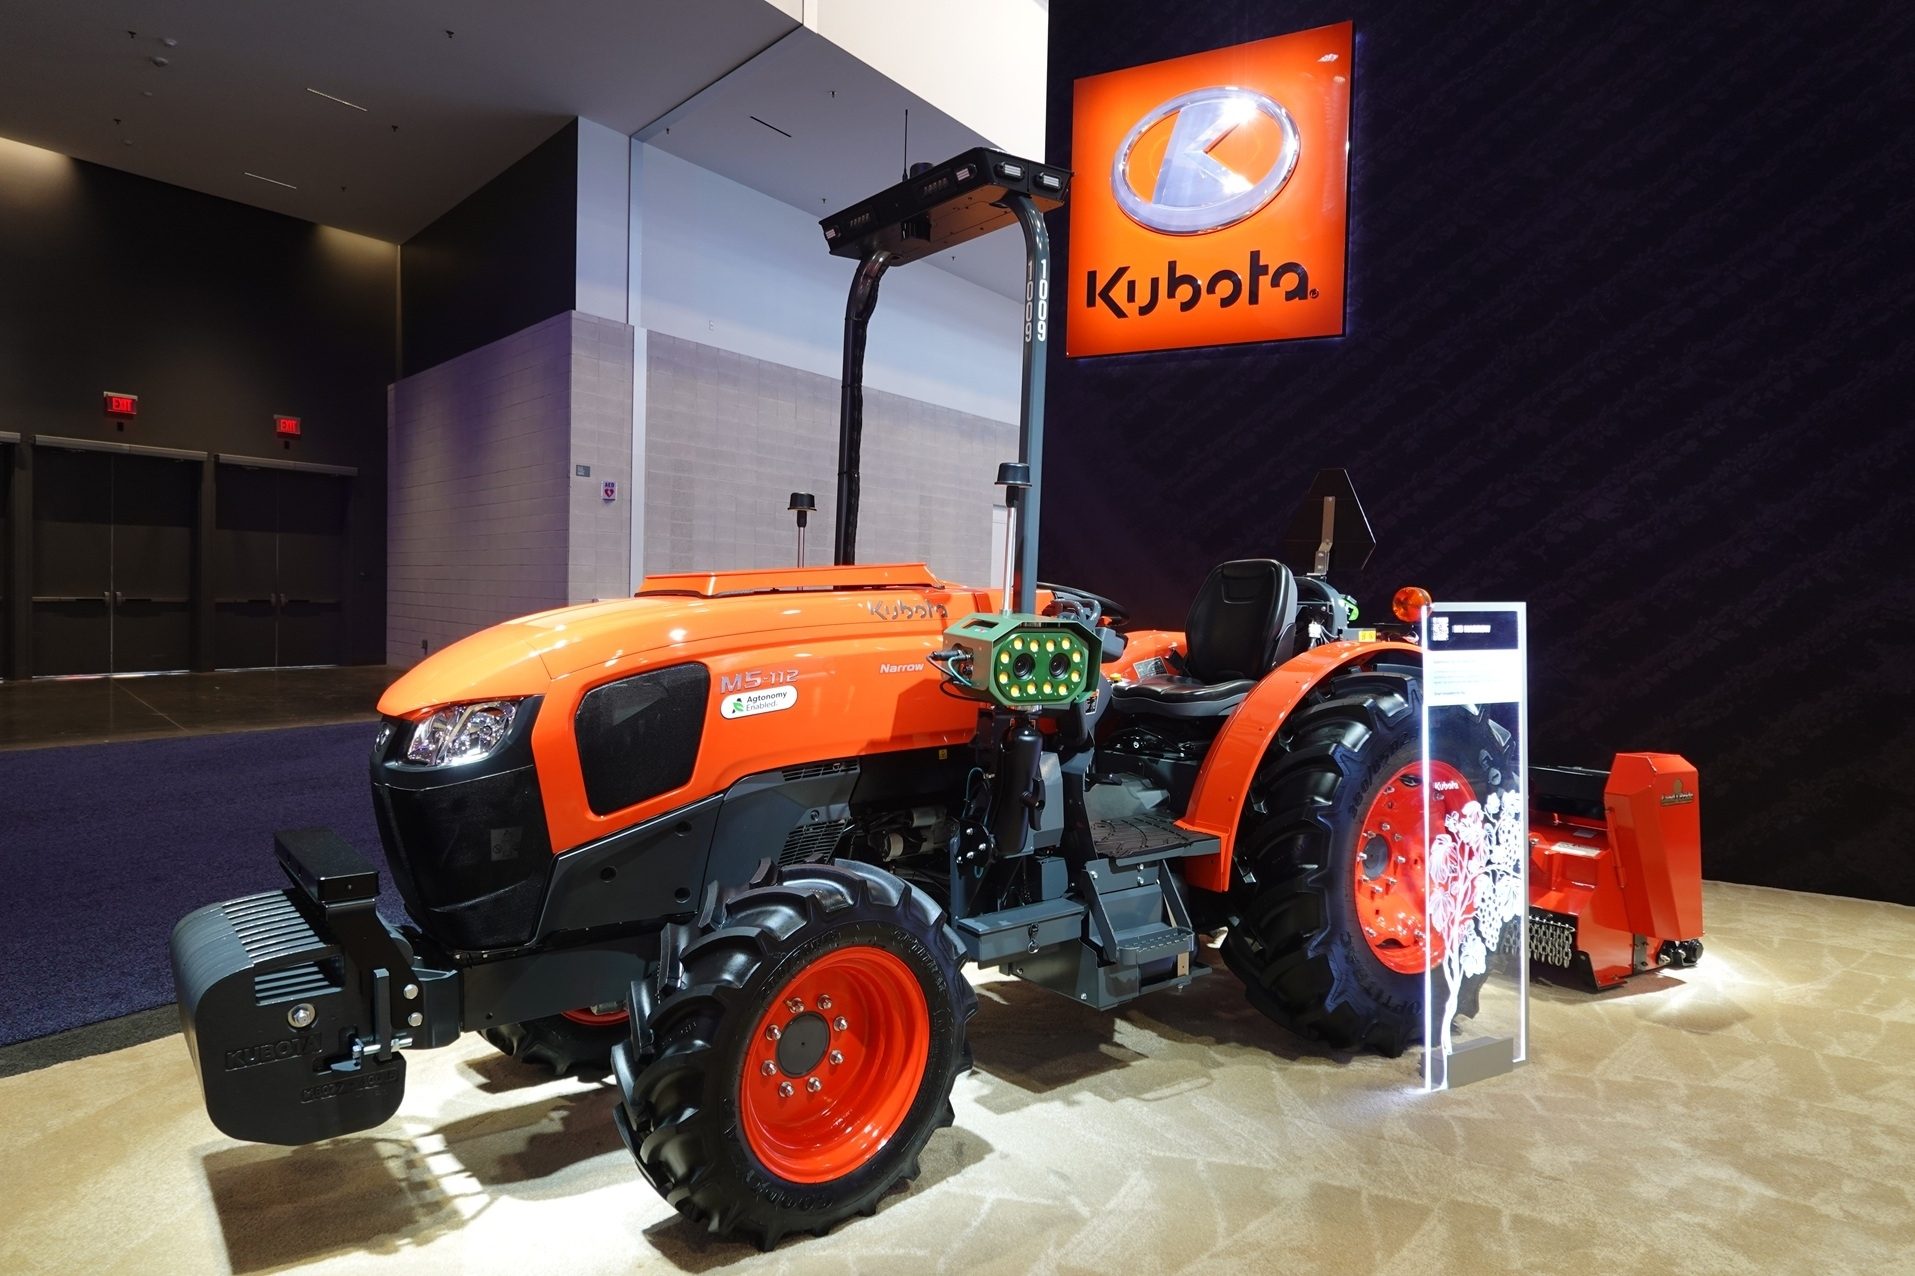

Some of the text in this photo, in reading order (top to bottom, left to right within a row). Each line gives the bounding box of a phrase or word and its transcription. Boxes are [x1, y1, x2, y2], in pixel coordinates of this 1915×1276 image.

[1086, 249, 1309, 320] Kubota
[1025, 260, 1033, 342] 1009
[1037, 258, 1048, 342] 1009
[112, 397, 132, 412] EXIT
[280, 419, 297, 433] EXIT
[866, 599, 948, 621] Kubota
[880, 663, 924, 674] Narrow
[720, 669, 800, 694] M5-112
[746, 691, 788, 704] Agtonomy
[1434, 780, 1459, 791] Kubota
[226, 1033, 321, 1070] KUBOTA
